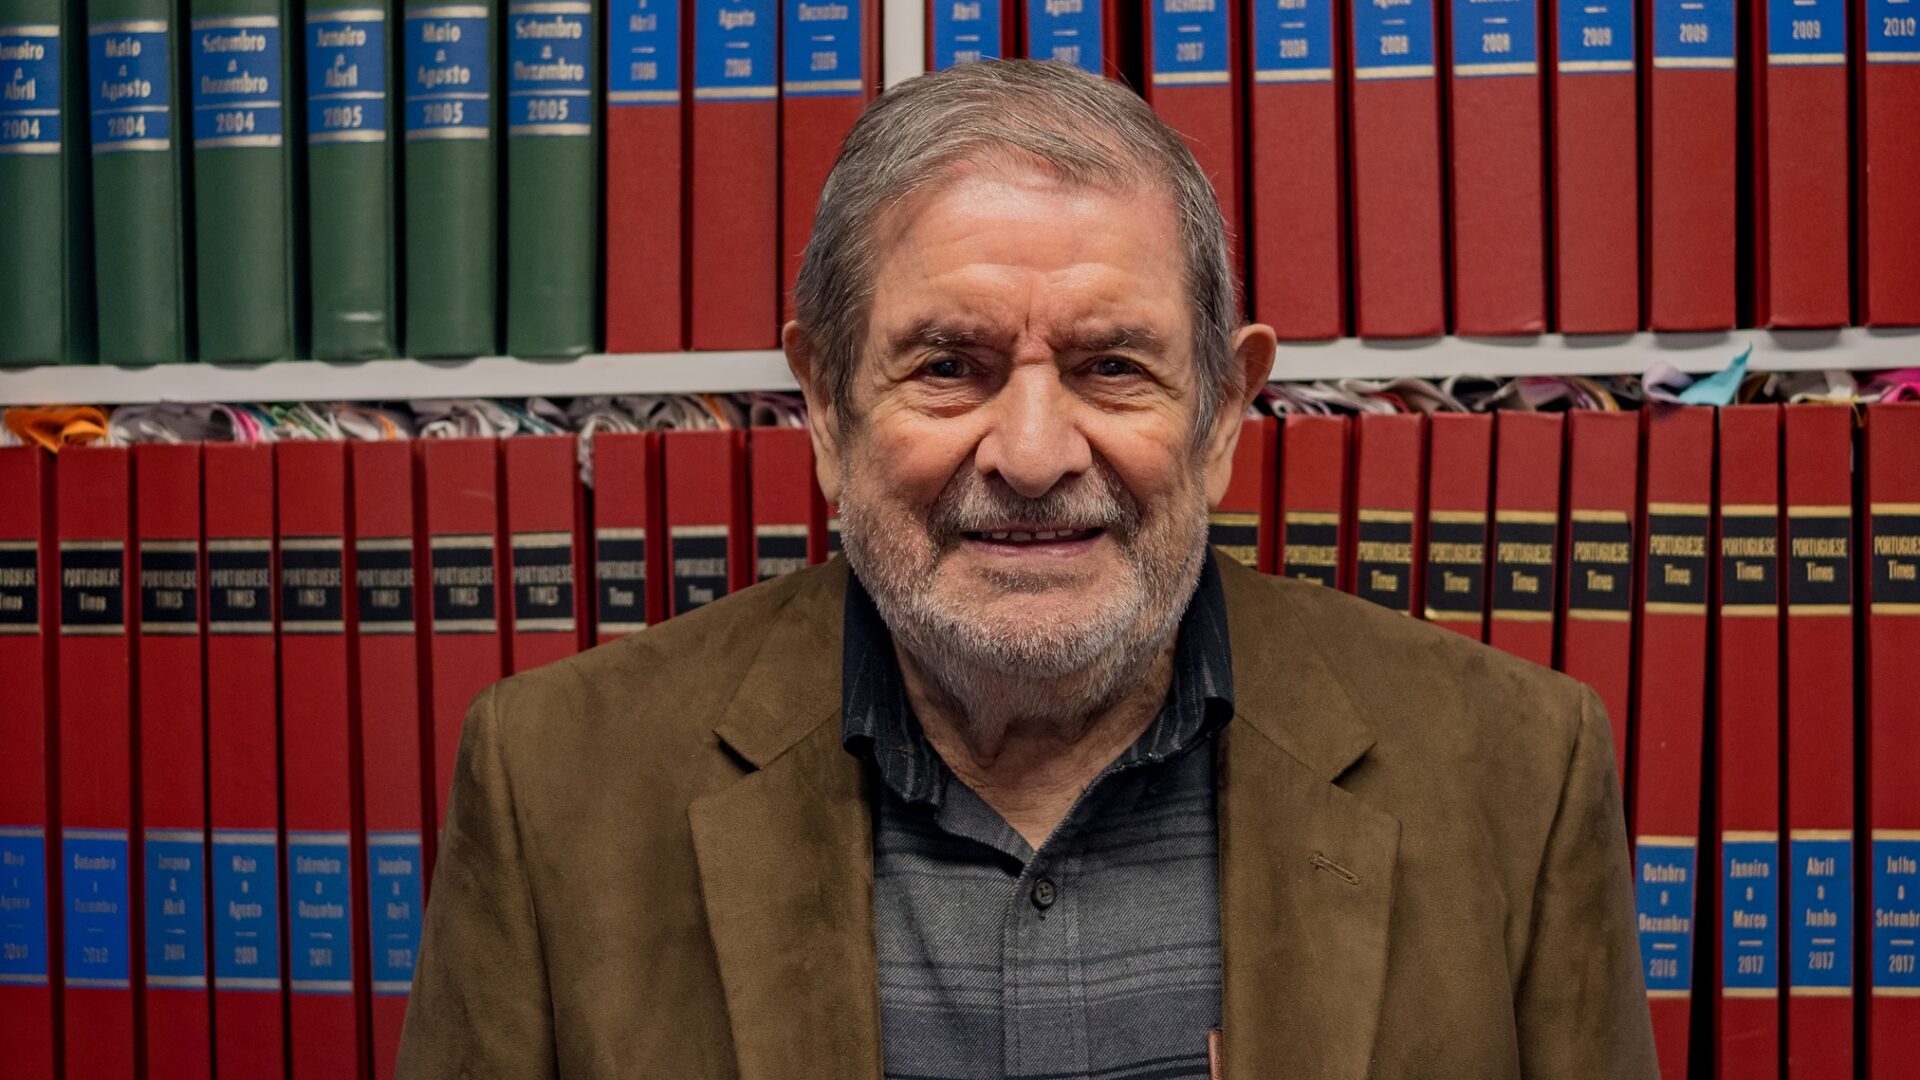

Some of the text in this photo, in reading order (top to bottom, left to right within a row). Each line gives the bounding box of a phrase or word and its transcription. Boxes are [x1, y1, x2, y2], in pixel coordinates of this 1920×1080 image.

[317, 26, 366, 47] Janeiro
[422, 23, 461, 42] Maio
[516, 16, 582, 39] Setembro
[1583, 27, 1611, 46] 2009
[1679, 23, 1708, 43] 2009
[1792, 20, 1821, 39] 2009
[1884, 17, 1915, 36] 2010
[105, 37, 141, 57] Maio
[202, 30, 266, 52] Setembro
[1176, 43, 1204, 61] 2007
[325, 64, 358, 87] Abril
[418, 65, 470, 88] Agosto
[514, 58, 584, 80] Dezembro
[5, 79, 36, 100] Abril
[101, 80, 151, 101] Agosto
[201, 71, 268, 93] Dezembro
[323, 106, 363, 127] 2005
[423, 102, 463, 124] 2005
[527, 100, 568, 120] 2005
[3, 119, 40, 139] 2004
[108, 116, 146, 137] 2004
[216, 112, 255, 132] 2004
[1498, 543, 1552, 564] PORTUGUESE
[1574, 542, 1629, 563] PORTUGUESE
[1650, 535, 1704, 556] PORTUGUESE
[1722, 537, 1776, 557] PORTUGUESE
[1792, 538, 1847, 557] PORTUGUESE
[1874, 536, 1920, 555] PORTUGUES
[64, 568, 121, 588] PORTUGUESE
[142, 570, 197, 588] PORTUGUESE
[211, 568, 270, 587] PORTUGUESE
[283, 568, 341, 586] PORTUGUESE
[357, 568, 414, 586] PORTUGUESE
[433, 566, 493, 584] PORTUGUESE
[513, 564, 573, 583] PORTUGUESE
[1664, 563, 1691, 585] Times
[1736, 560, 1764, 580] Times
[1806, 561, 1834, 582] Times
[1888, 560, 1915, 580] Times
[1370, 570, 1398, 591] Times
[1444, 571, 1470, 592] Times
[1512, 570, 1539, 593] Times
[1587, 570, 1614, 592] Times
[79, 592, 107, 611] Times
[156, 590, 183, 609] TIMES
[227, 589, 256, 608] TIMES
[372, 589, 400, 607] TIMES
[450, 587, 479, 604] TIMES
[528, 586, 559, 605] TIMES
[74, 853, 116, 870] Setembro
[232, 855, 256, 872] Maio
[296, 855, 341, 874] Setembro
[1730, 858, 1769, 878] Janeiro
[1806, 857, 1834, 876] Abril
[1887, 855, 1917, 874] Julho
[1643, 862, 1686, 883] Outubro
[1660, 890, 1668, 905] a
[1746, 886, 1753, 901] a
[1817, 884, 1824, 900] a
[1898, 884, 1905, 900] a
[229, 901, 262, 920] Agosto
[1806, 908, 1837, 927] Junho
[1876, 907, 1920, 928] Setembr
[1639, 912, 1690, 932] Dezembro
[1738, 954, 1764, 975] 2017
[1808, 951, 1834, 970] 2017
[1888, 954, 1915, 974] 2017
